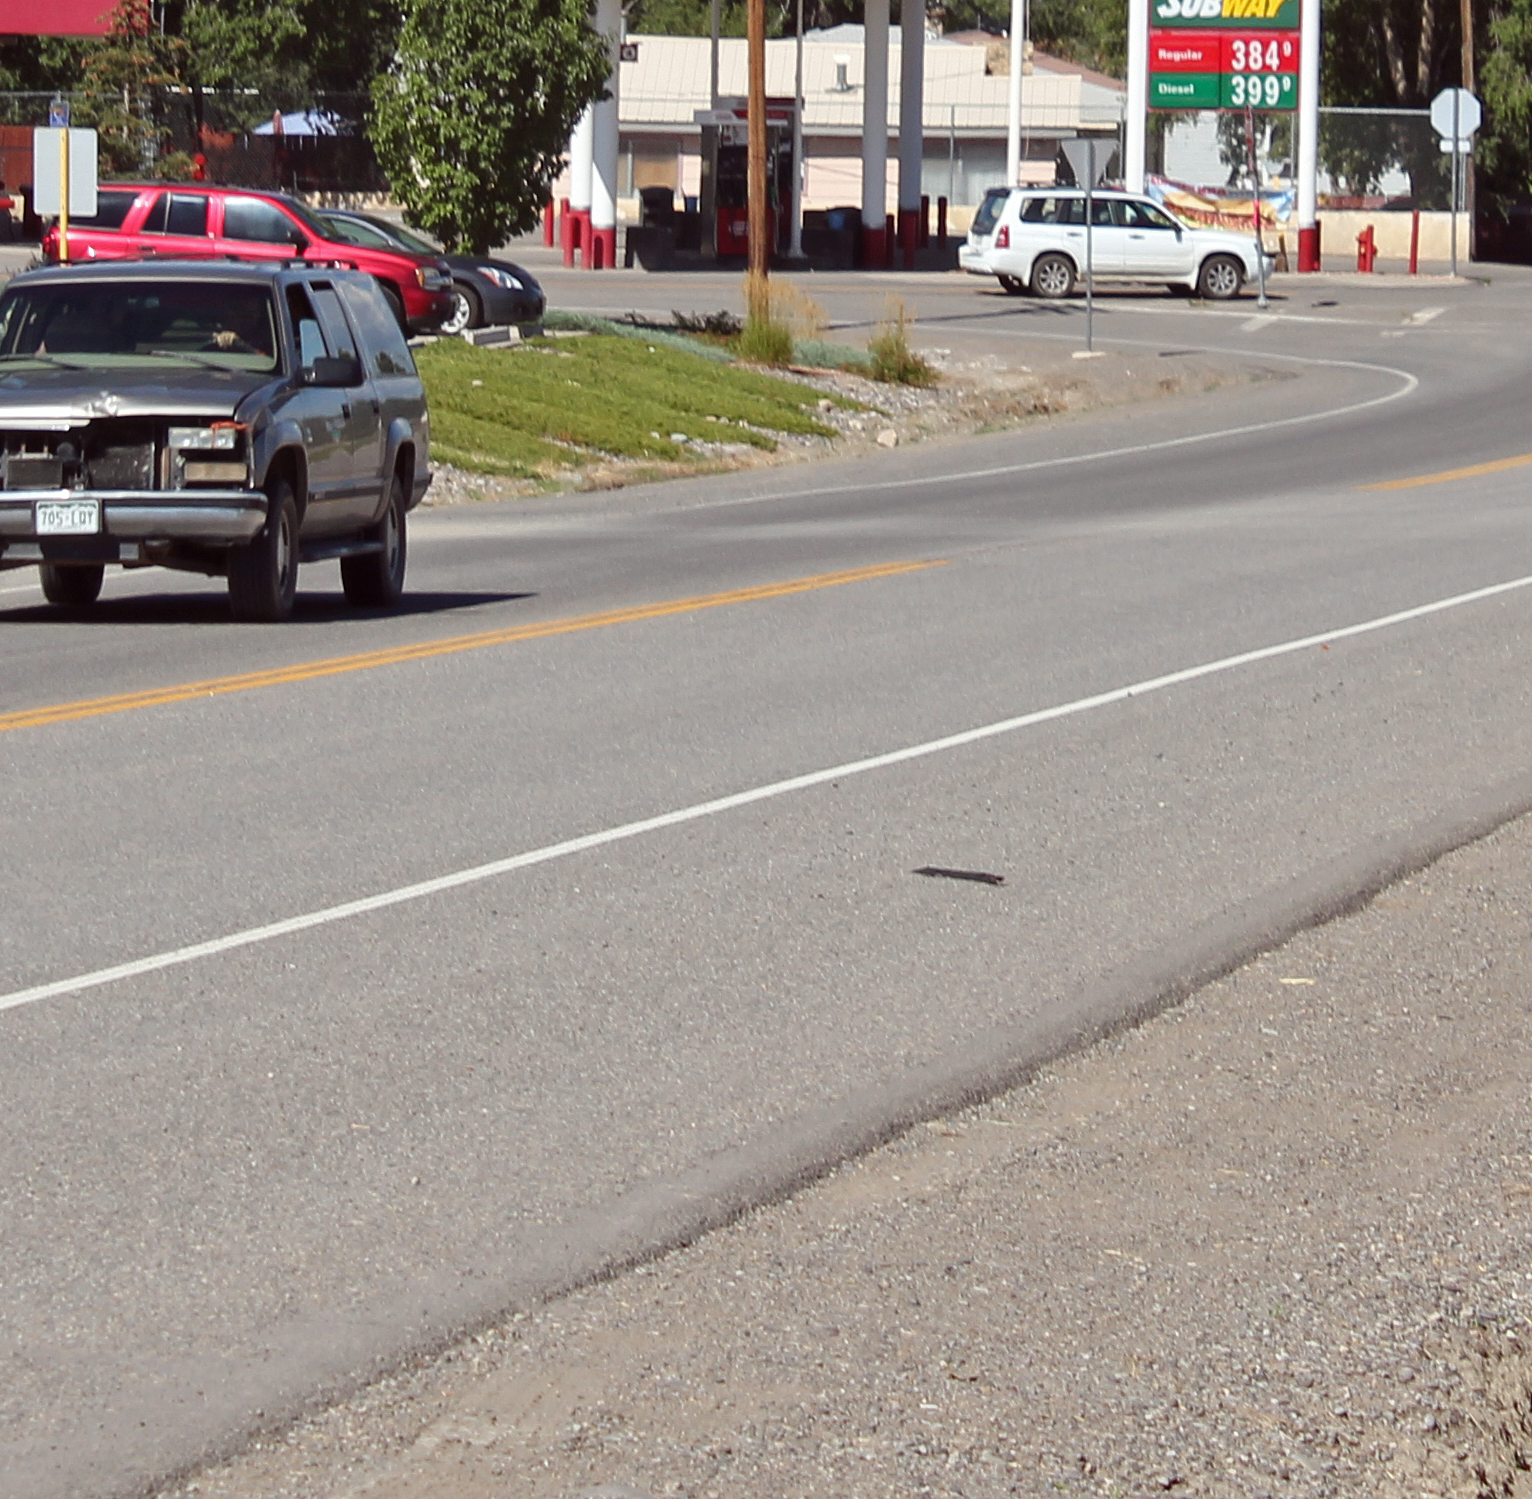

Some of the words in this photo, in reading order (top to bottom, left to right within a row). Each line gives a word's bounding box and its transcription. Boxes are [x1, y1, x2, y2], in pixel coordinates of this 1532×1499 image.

[1157, 48, 1203, 62] Regular
[1231, 40, 1280, 71] 384
[1157, 83, 1195, 95] Diesel
[1231, 75, 1280, 105] 399
